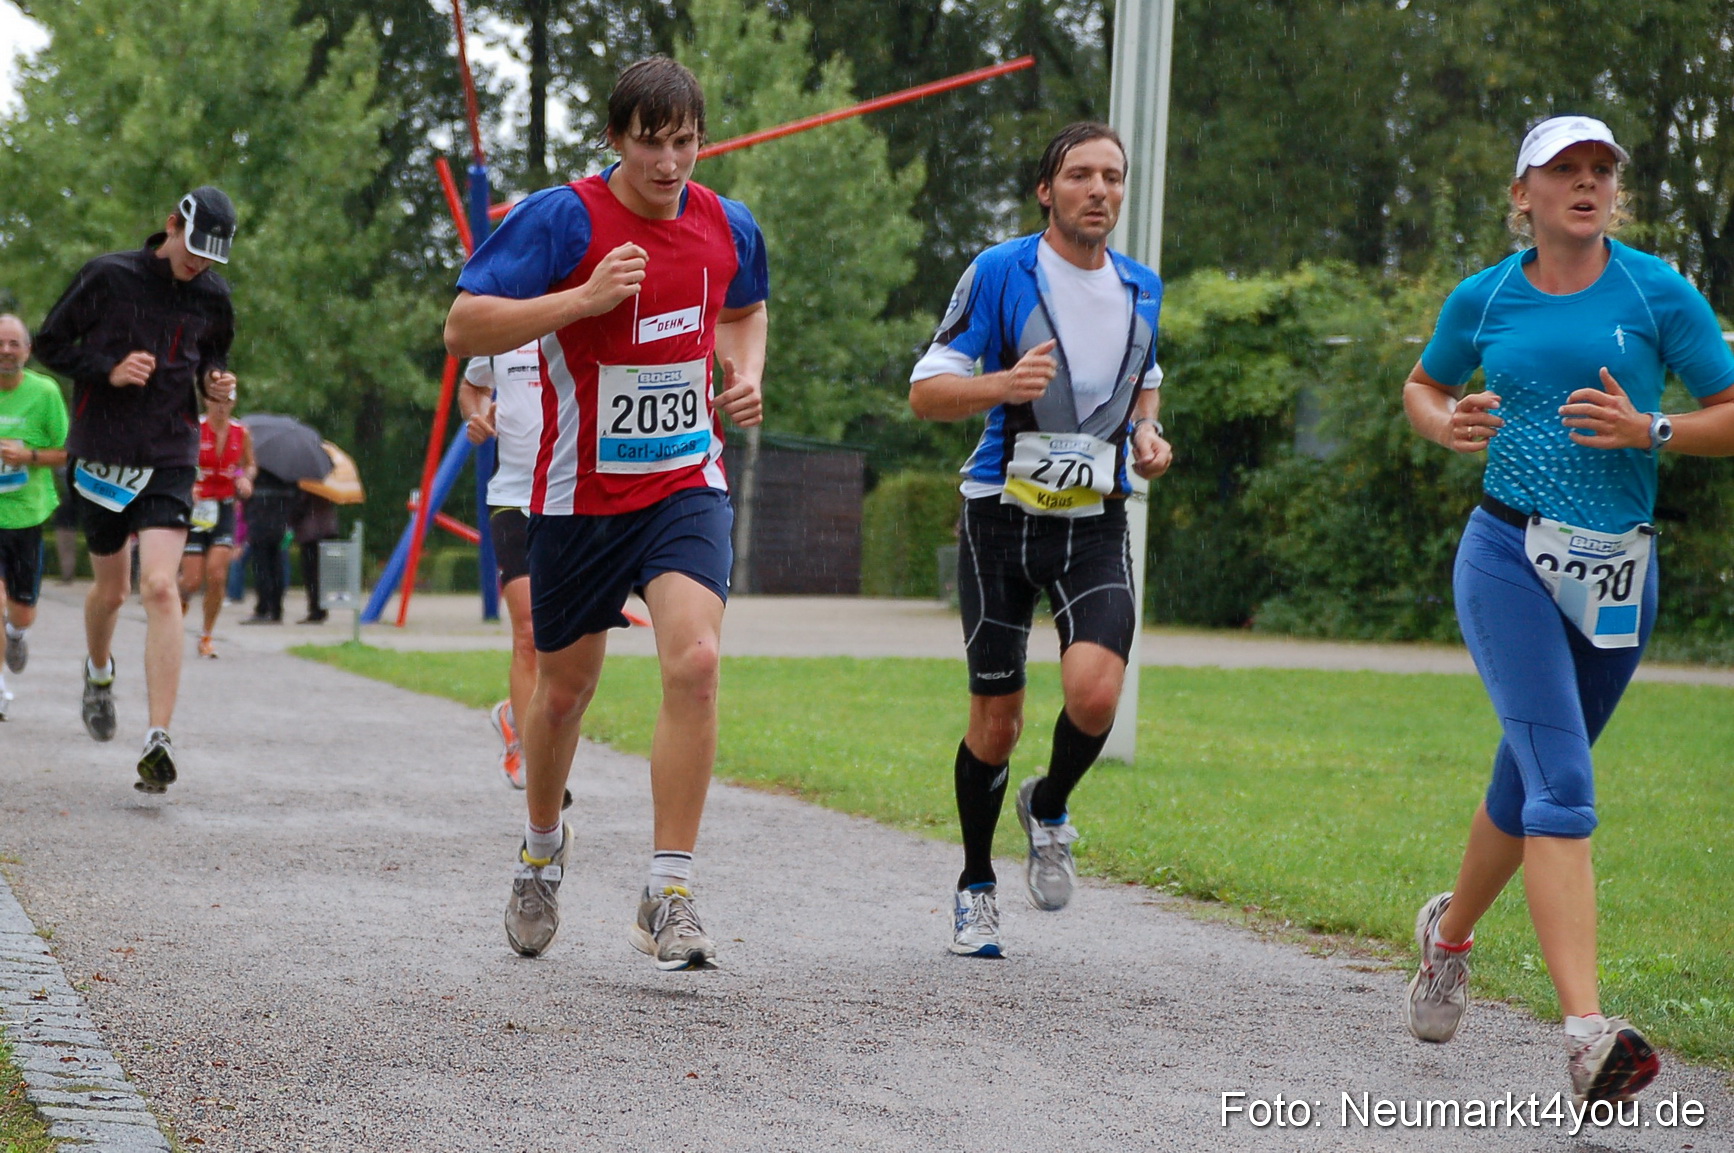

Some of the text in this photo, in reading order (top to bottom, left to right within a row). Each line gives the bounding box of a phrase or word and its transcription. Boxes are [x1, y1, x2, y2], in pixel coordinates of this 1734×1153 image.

[657, 317, 684, 332] DEHN
[637, 370, 682, 384] BOCK
[611, 389, 698, 435] 2039
[617, 440, 698, 459] Carl-Jonas
[1030, 458, 1093, 489] 270
[93, 483, 117, 499] Felix
[1036, 492, 1073, 508] Klaus
